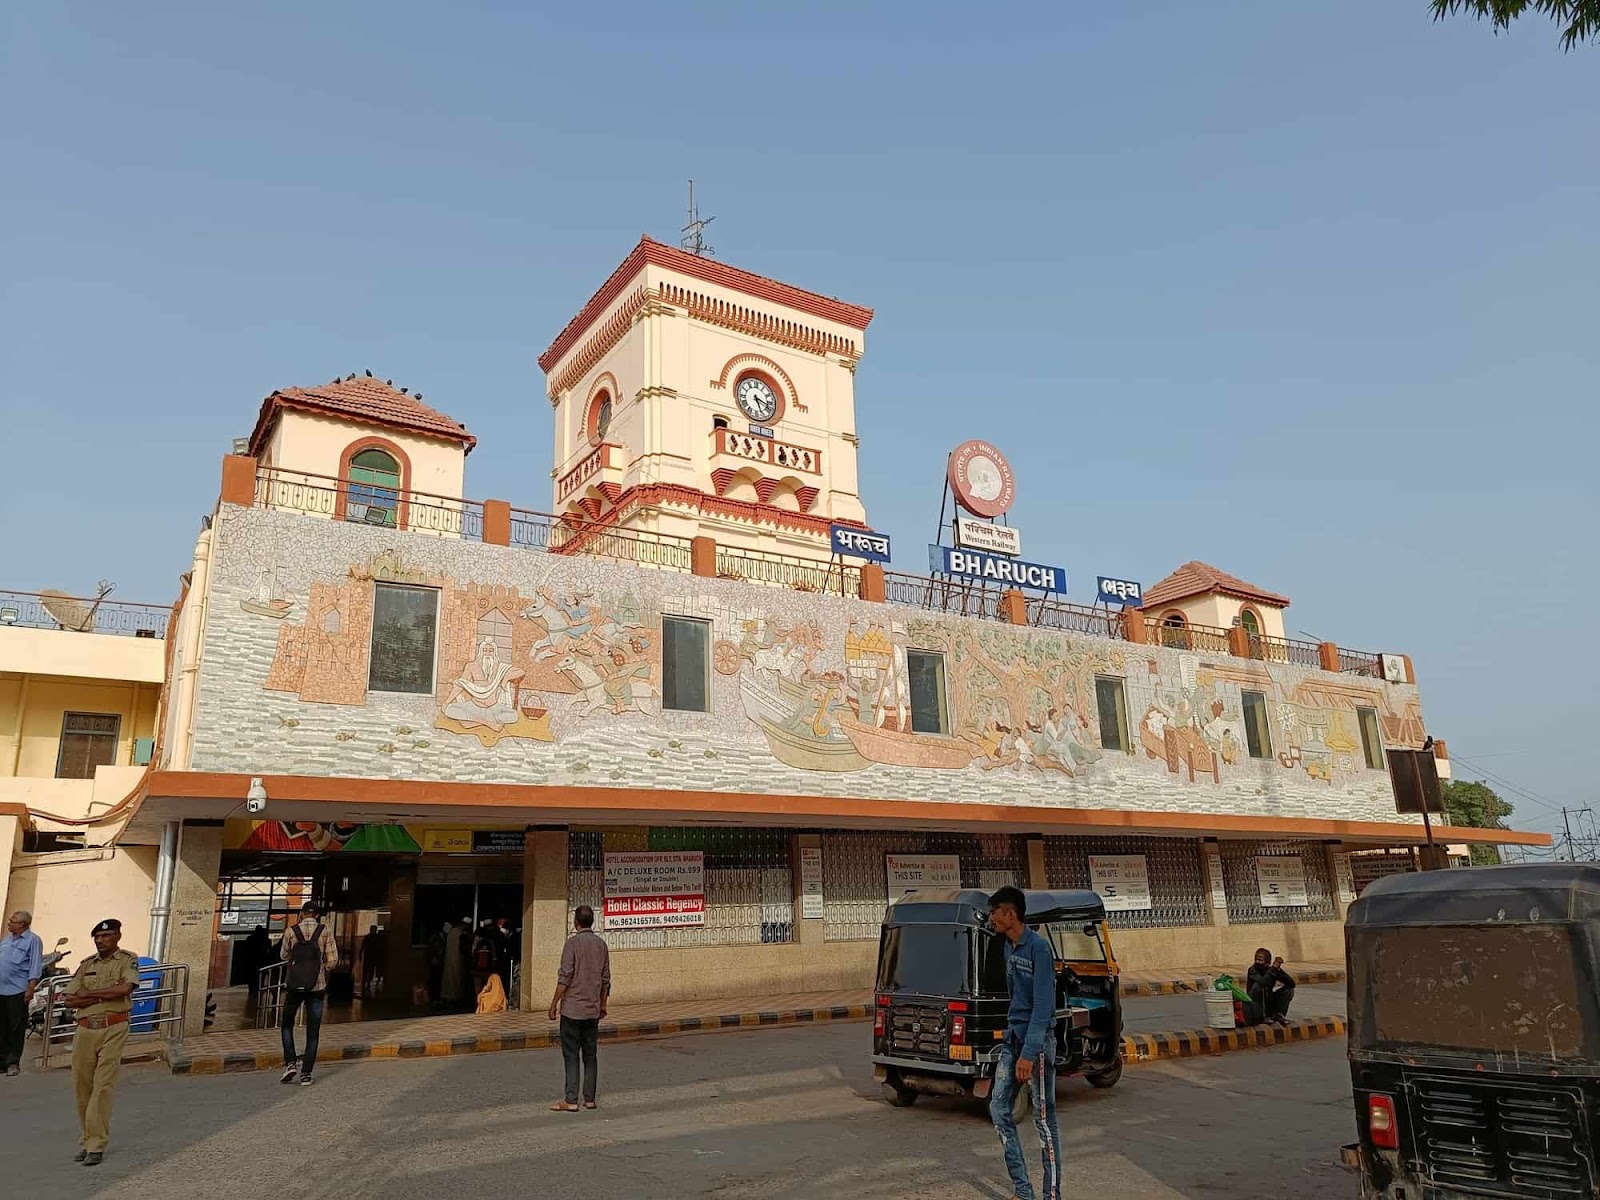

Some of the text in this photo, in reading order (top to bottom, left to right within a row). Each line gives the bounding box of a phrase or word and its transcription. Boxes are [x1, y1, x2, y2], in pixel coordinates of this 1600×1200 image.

[978, 444, 1012, 508] INDIAN RAILWAYS
[964, 522, 1014, 541] पश्चिम रेलवे
[835, 530, 889, 556] भरूच
[964, 534, 1016, 552] Western Railway
[949, 551, 1056, 589] BHARUCH
[607, 866, 701, 876] A/C DELUXE ROOM Rs.999
[894, 871, 908, 880] THIS
[909, 871, 922, 880] SITE
[607, 897, 703, 913] Hotel Classic Regency
